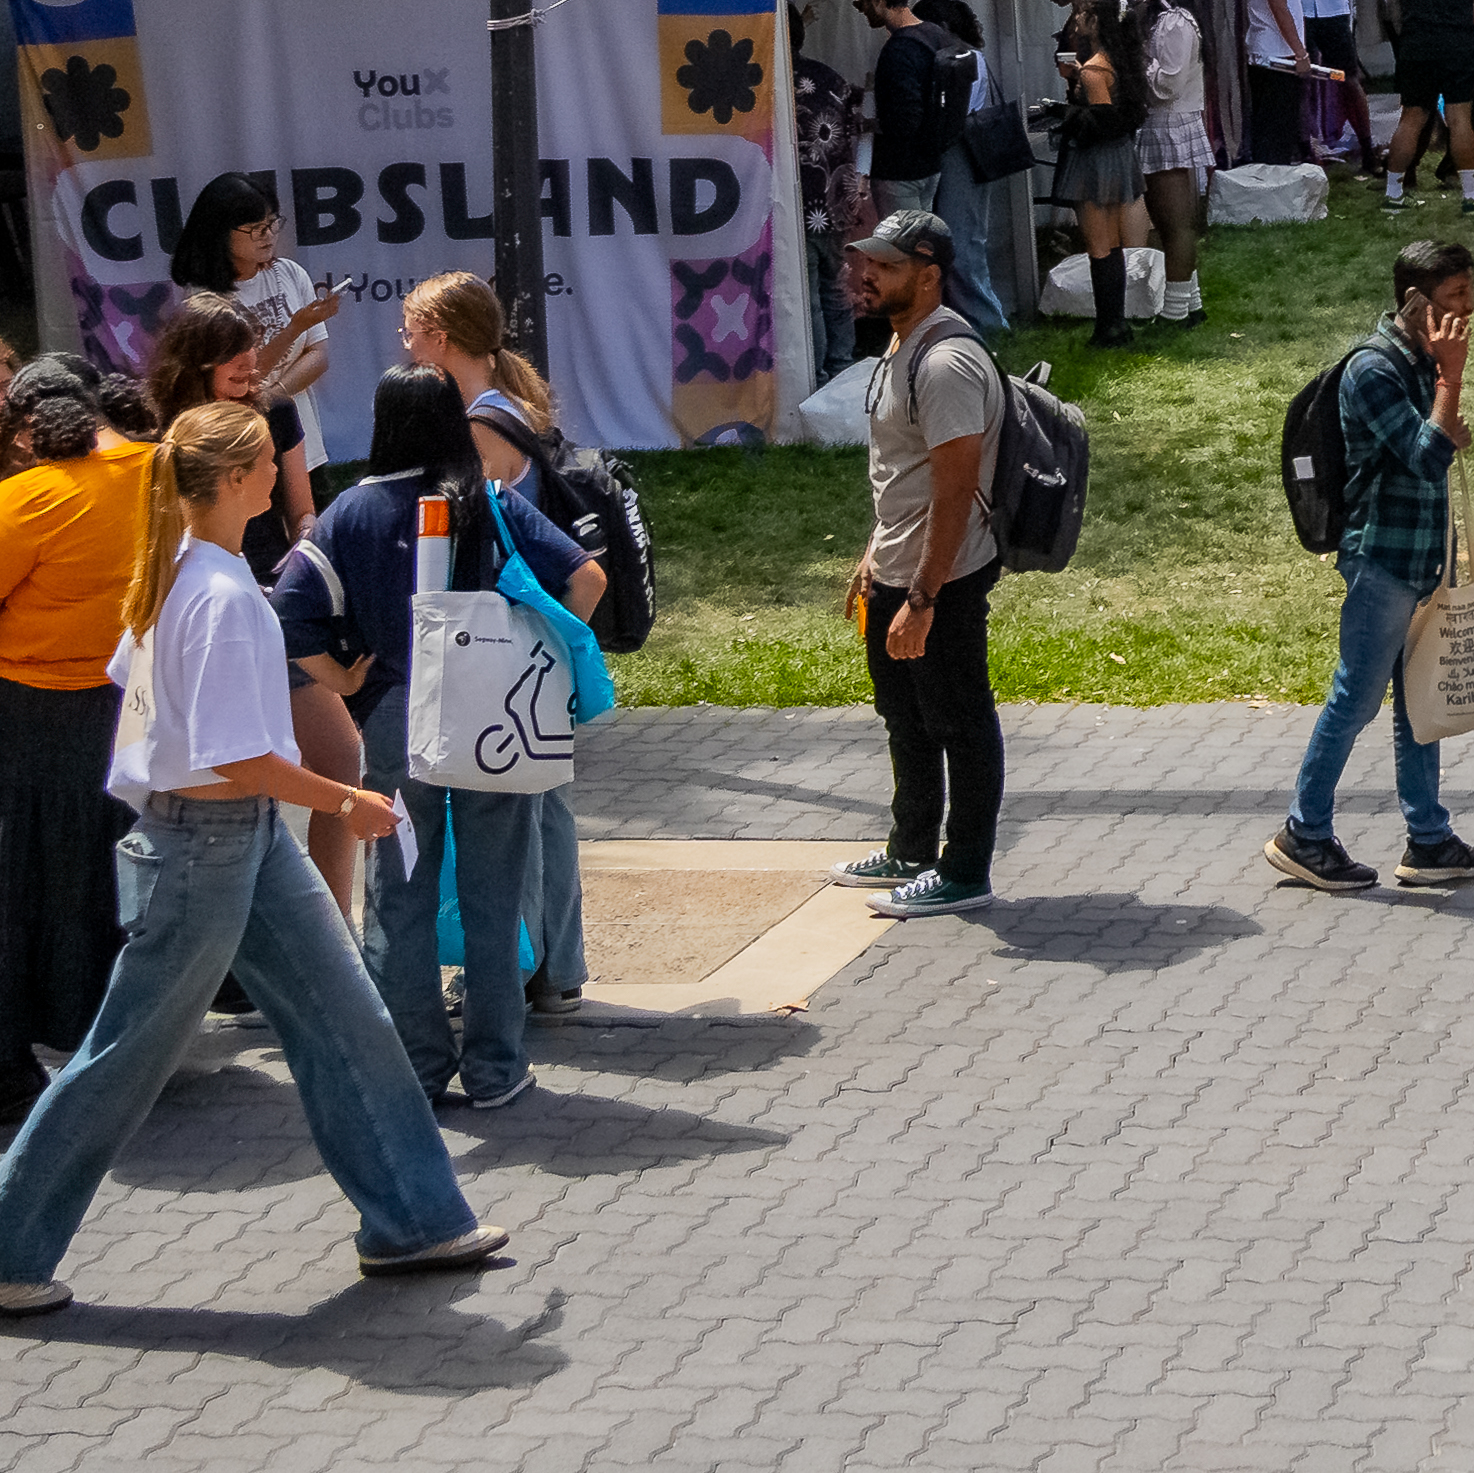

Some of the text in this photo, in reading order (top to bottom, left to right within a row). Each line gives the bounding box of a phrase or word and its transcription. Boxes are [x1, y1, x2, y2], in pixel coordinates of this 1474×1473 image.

[353, 68, 451, 98] YouX
[357, 100, 455, 130] Clubs
[344, 272, 405, 303] You
